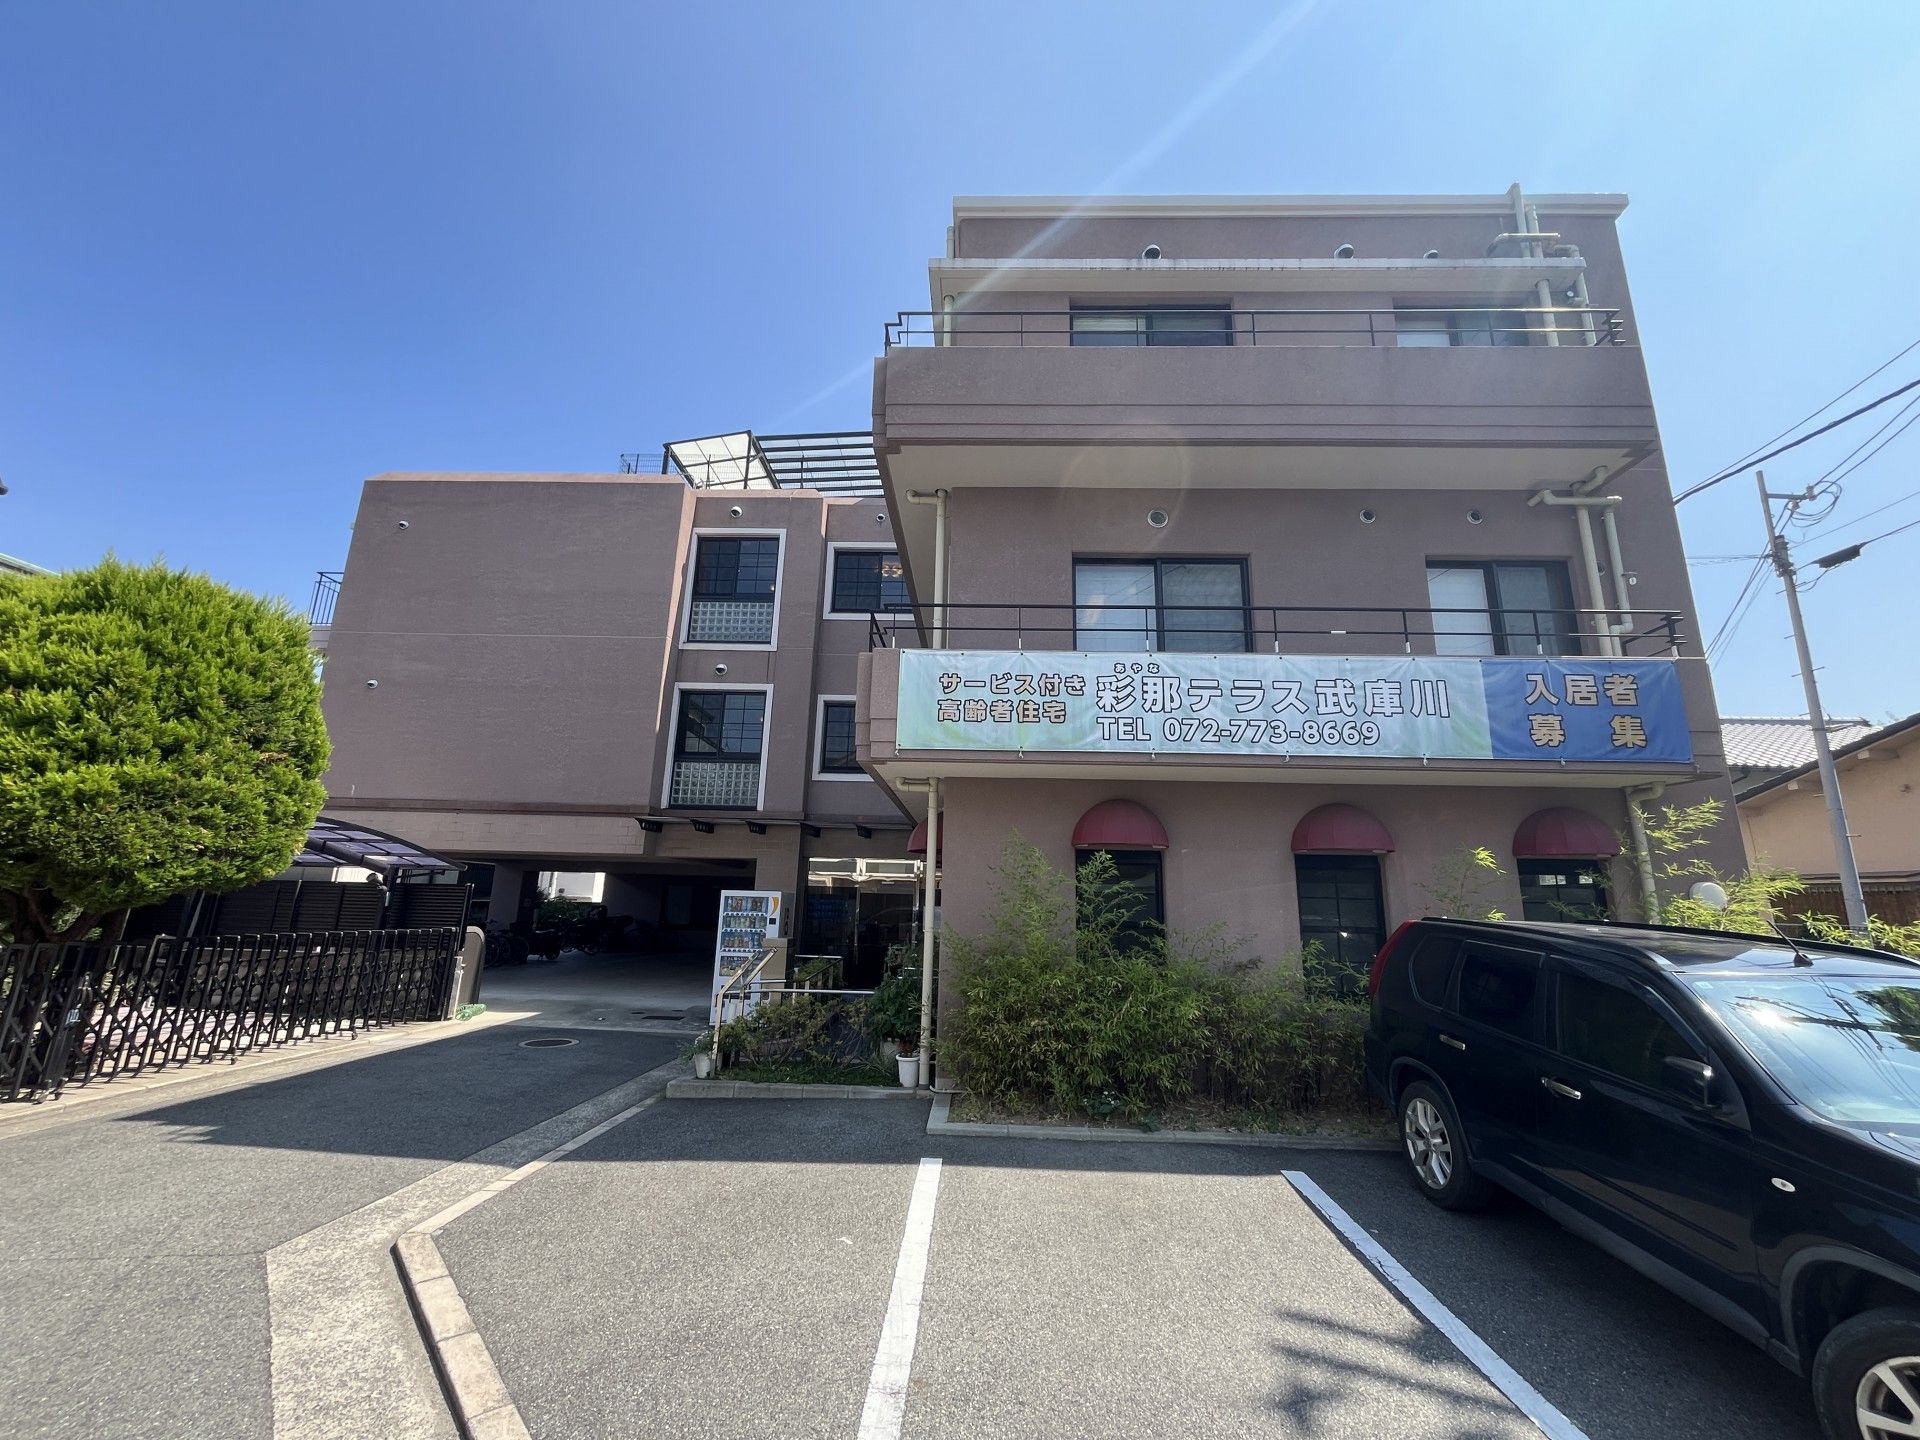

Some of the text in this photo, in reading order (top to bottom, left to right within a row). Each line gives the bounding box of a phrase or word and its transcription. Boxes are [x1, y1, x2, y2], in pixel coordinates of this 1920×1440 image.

[1114, 663, 1160, 674] あやな
[939, 672, 1087, 696] サービス付き
[1096, 675, 1451, 718] 彩那テラス武庫川
[1525, 673, 1639, 706] 入居者
[938, 699, 1067, 723] 高齢者住宅
[1096, 717, 1381, 745] TEL 072-773-8669
